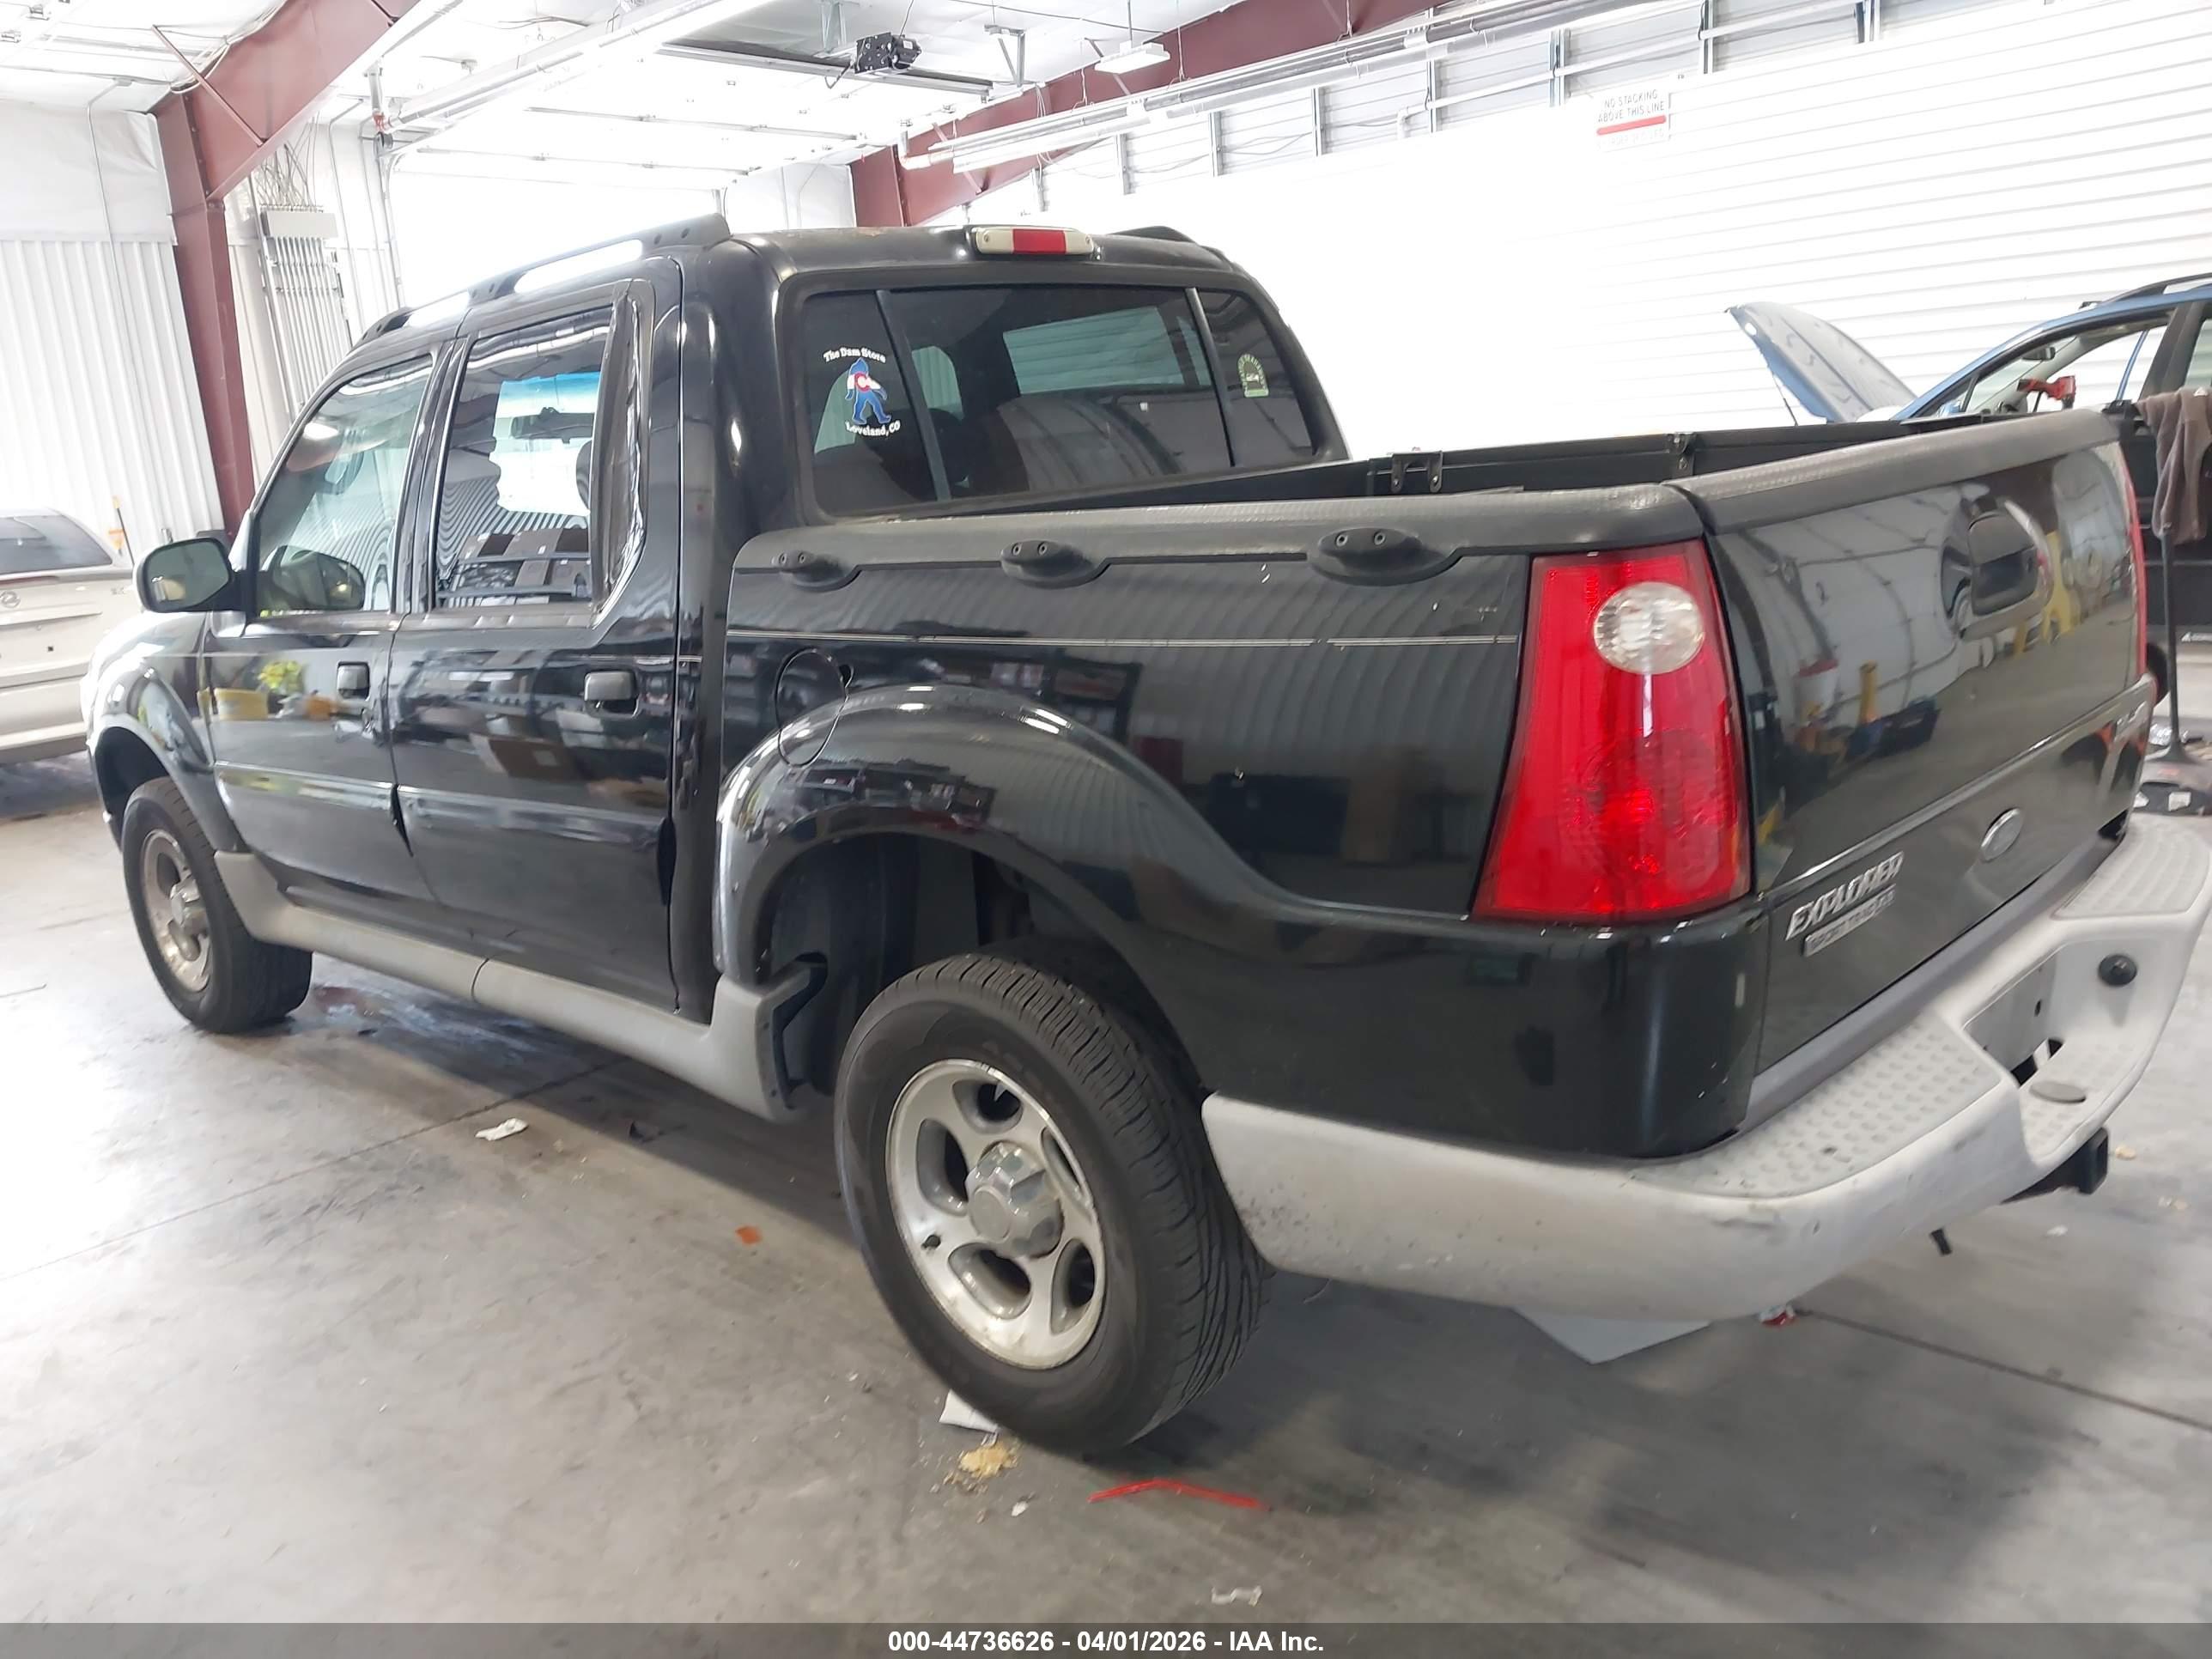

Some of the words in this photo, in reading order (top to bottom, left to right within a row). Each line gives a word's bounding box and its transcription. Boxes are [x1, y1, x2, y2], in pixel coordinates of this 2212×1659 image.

[1604, 97, 1616, 108] NO
[1619, 89, 1657, 106] STACKING
[1598, 109, 1623, 123] ABOVE
[1627, 105, 1644, 117] THIS
[1647, 100, 1665, 113] LINE
[823, 349, 840, 362] The
[840, 347, 860, 356] Dam
[861, 347, 886, 363] Store
[889, 420, 901, 434] CO
[1785, 851, 1904, 941] EXPLORER
